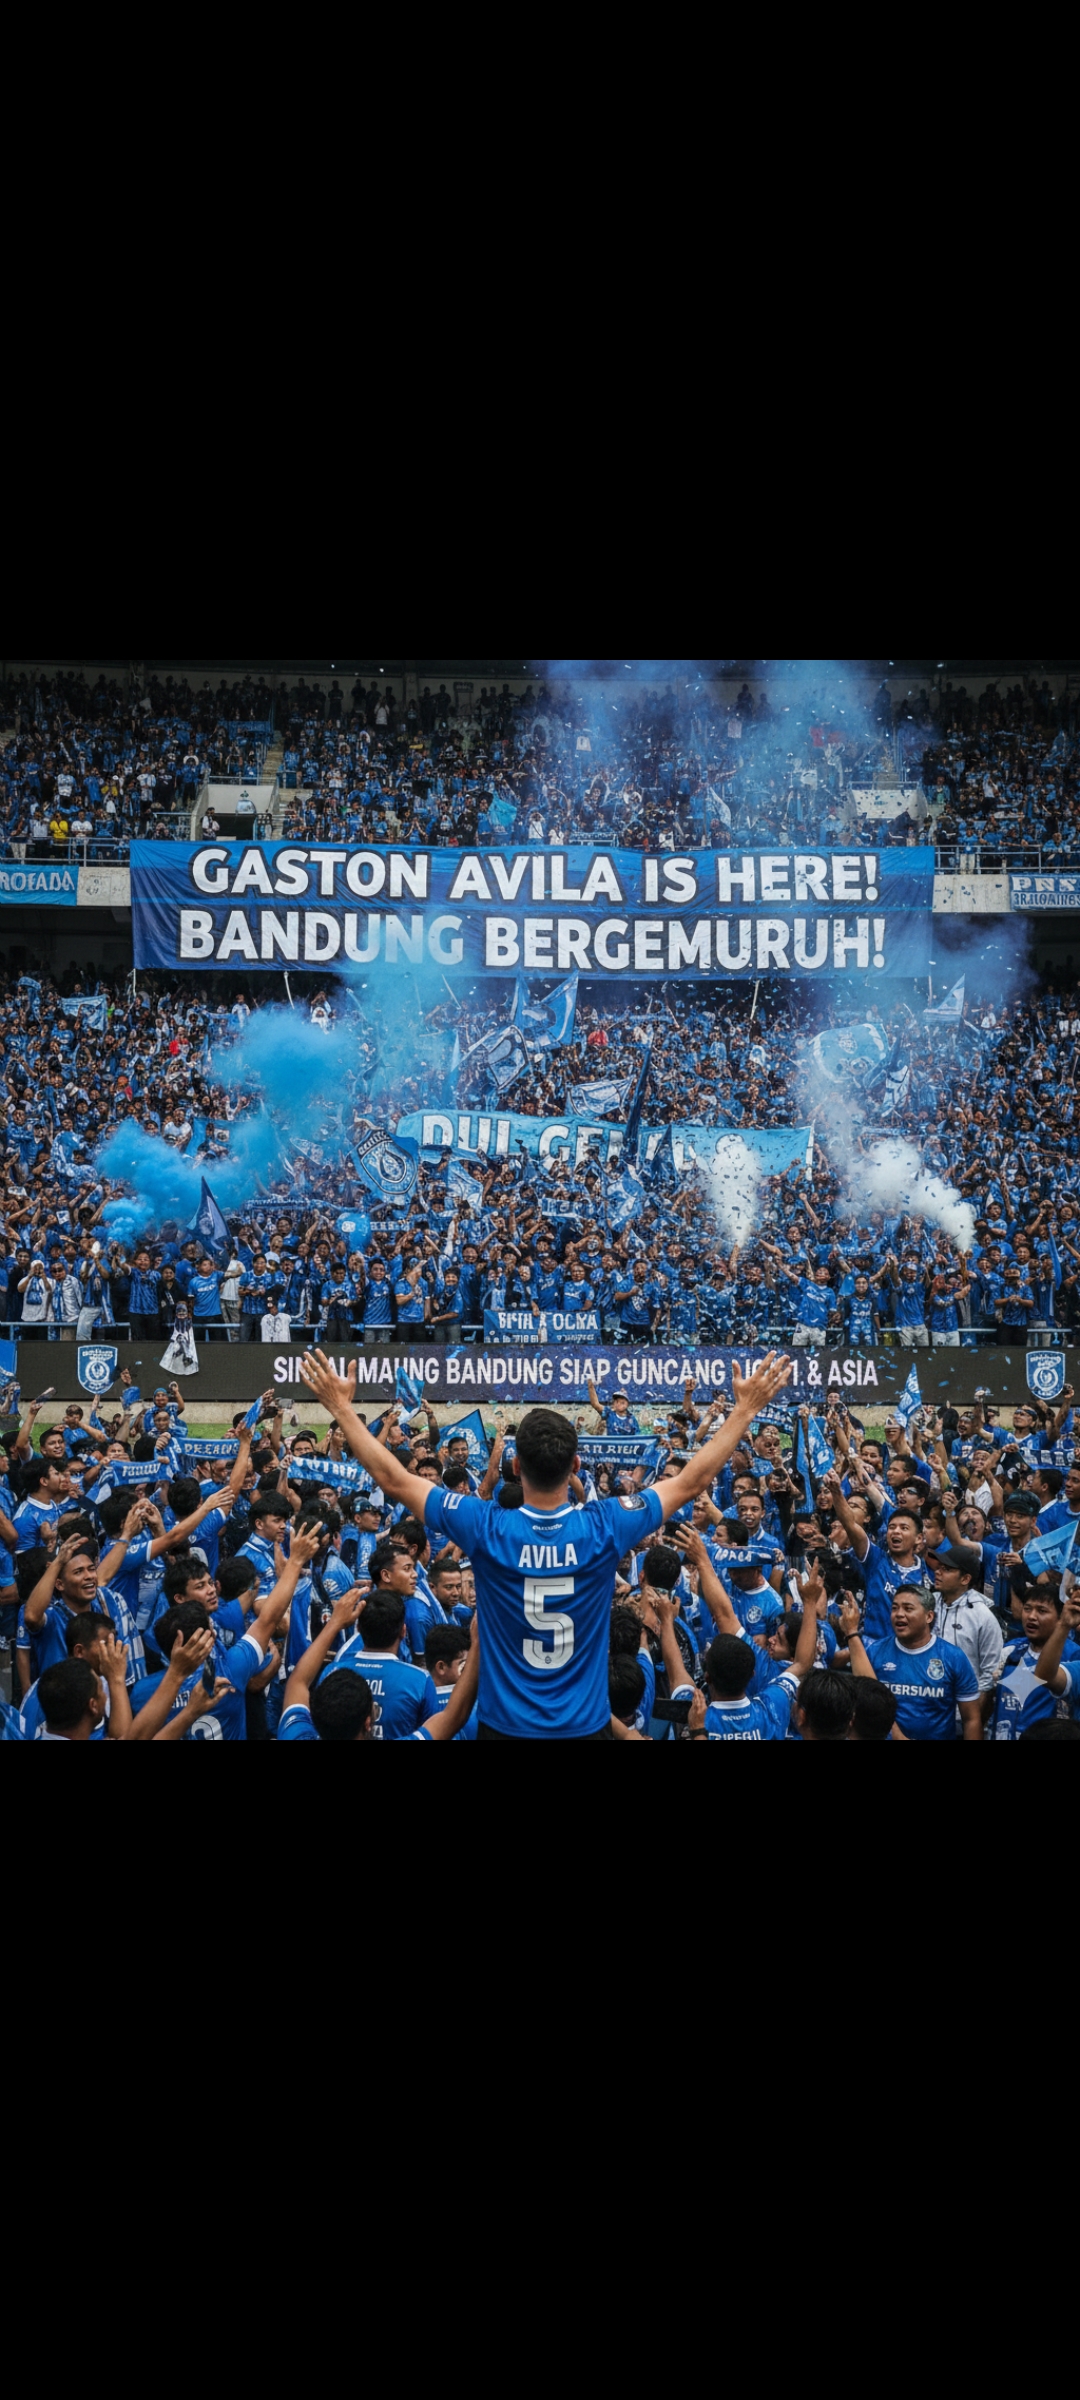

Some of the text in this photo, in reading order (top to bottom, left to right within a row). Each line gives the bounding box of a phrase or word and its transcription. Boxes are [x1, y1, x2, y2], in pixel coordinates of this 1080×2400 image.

[192, 848, 879, 902] GASTON AVILA IS HERE!
[179, 909, 886, 970] BANDUNG BERGEMURUH!
[446, 1357, 552, 1385] BANDUNG
[559, 1358, 611, 1386] SIAP
[617, 1358, 725, 1386] GUNCANG
[807, 1358, 823, 1386] &
[827, 1359, 879, 1386] ASIA
[518, 1543, 579, 1569] AVILA
[522, 1576, 575, 1670] 5
